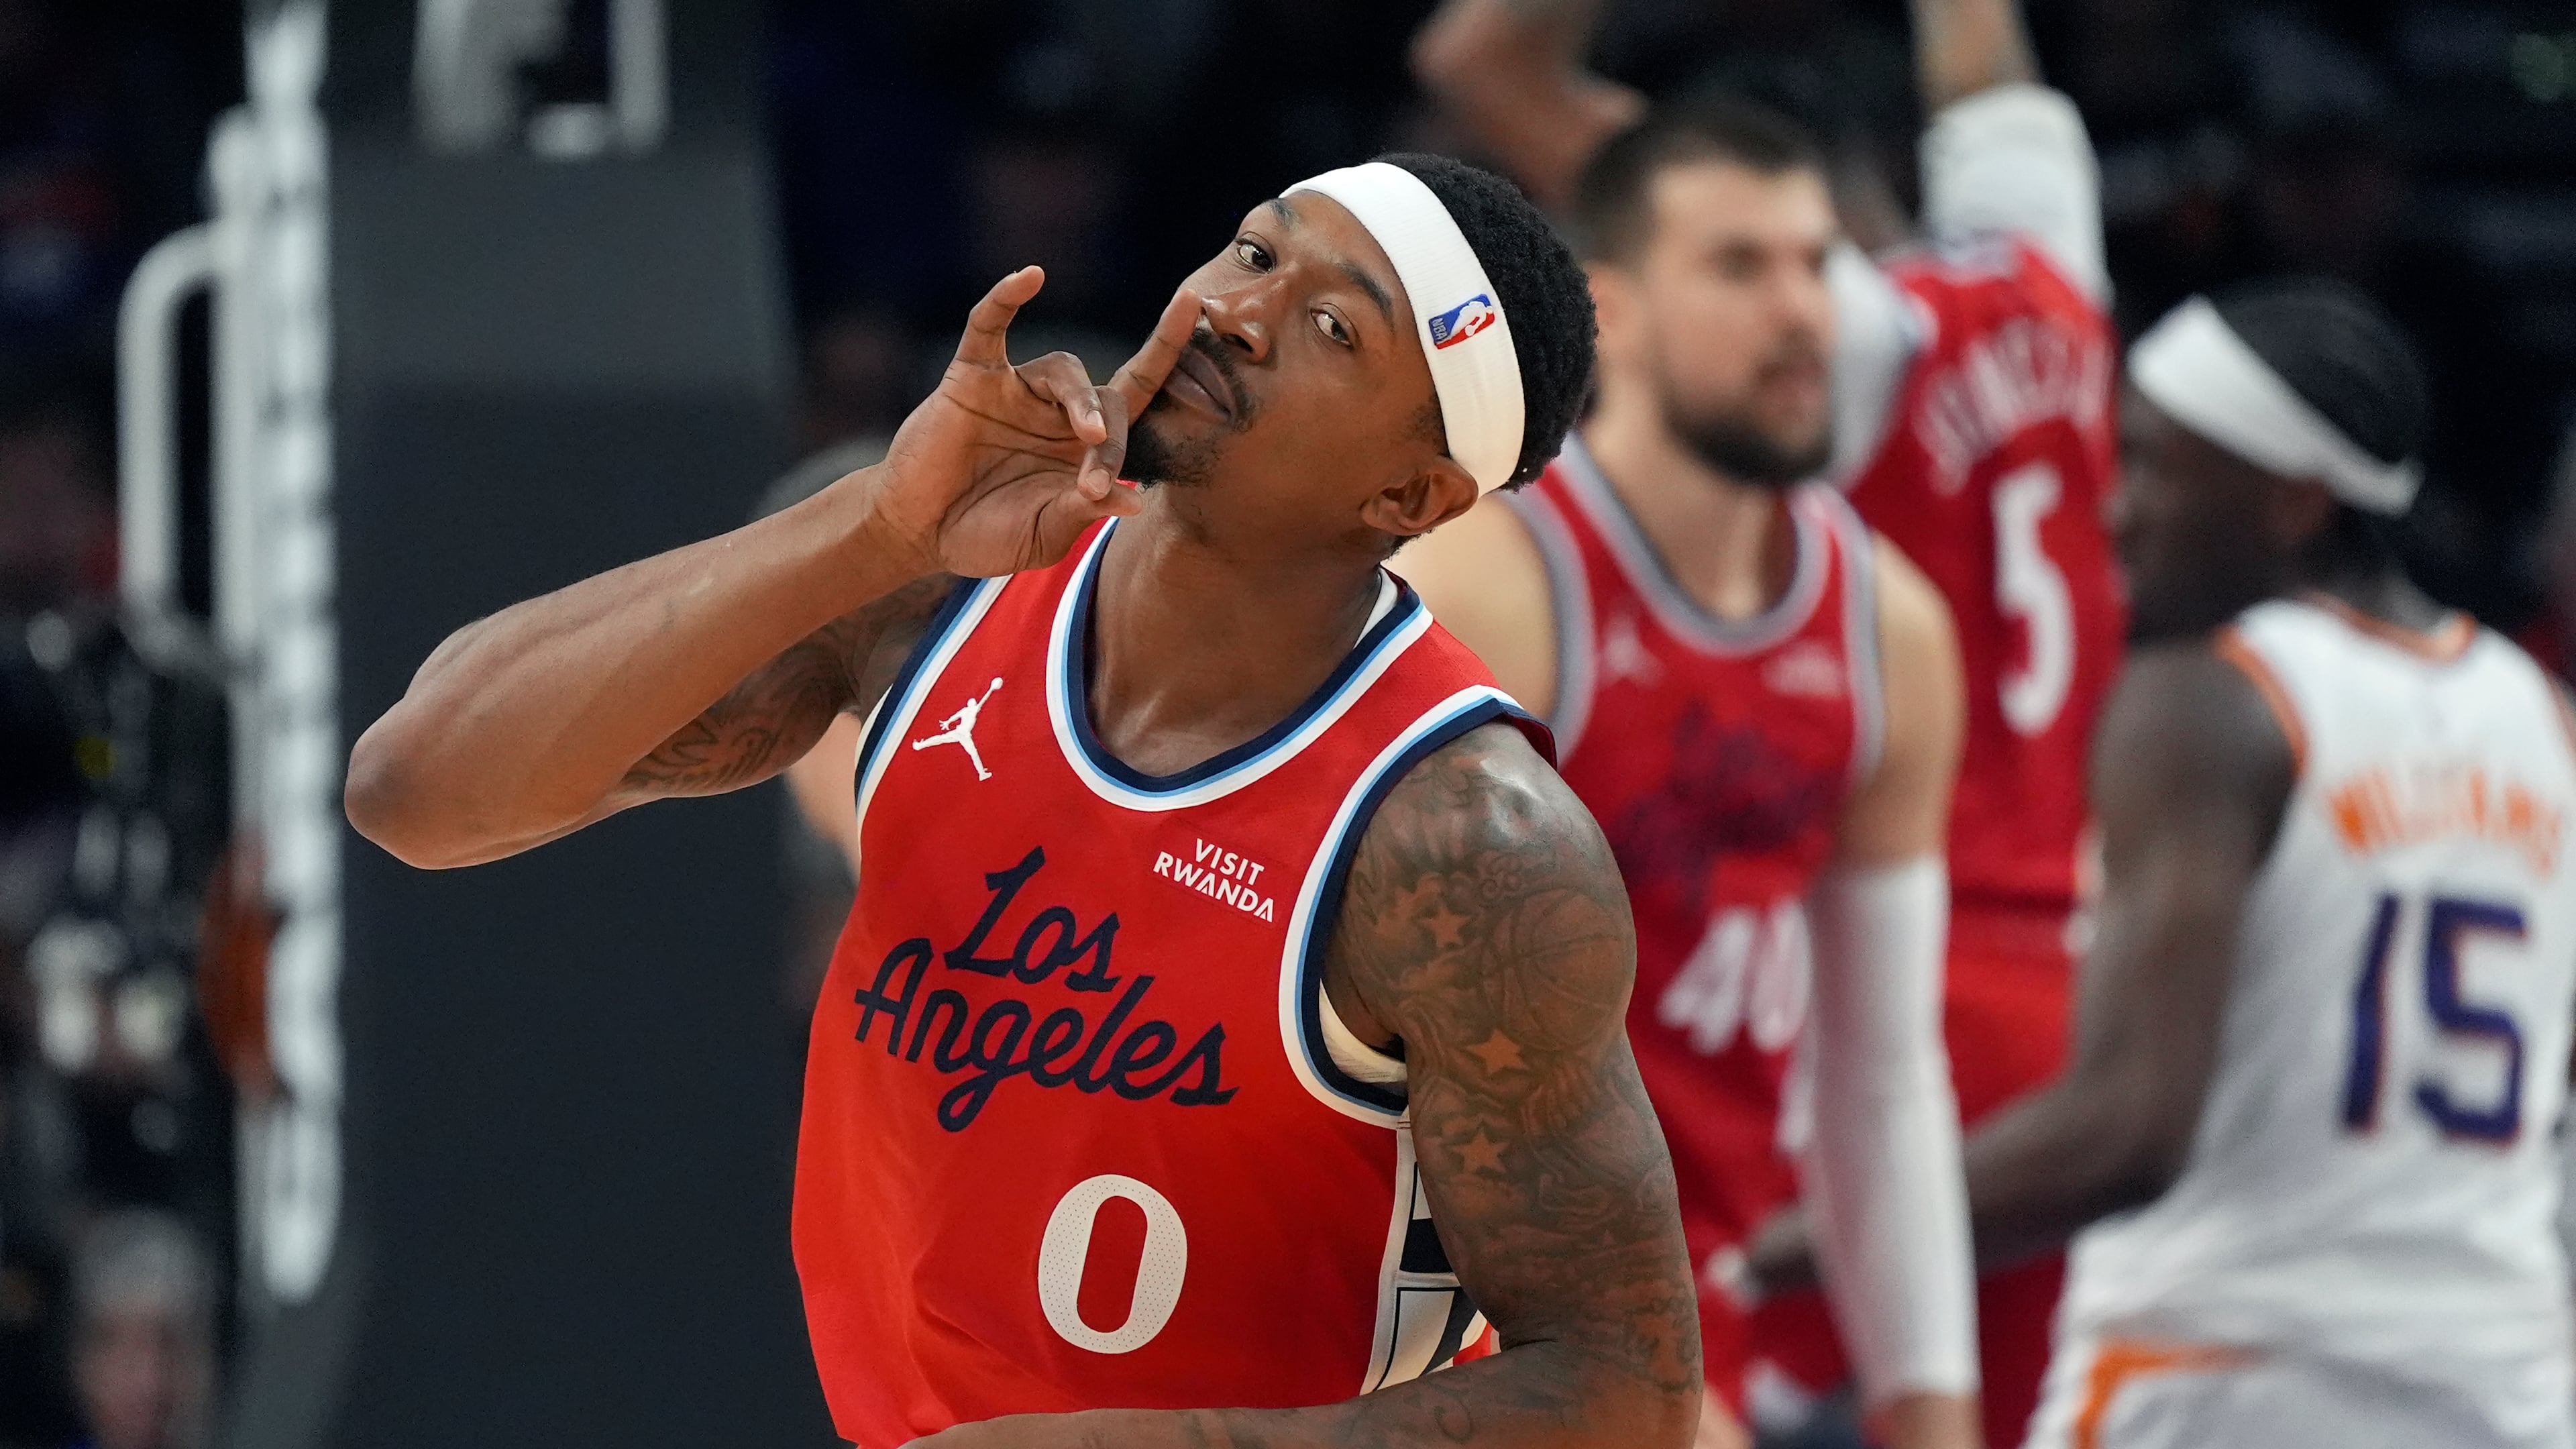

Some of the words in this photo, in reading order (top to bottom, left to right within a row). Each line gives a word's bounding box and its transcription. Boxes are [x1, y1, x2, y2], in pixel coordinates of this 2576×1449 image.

[1432, 317, 1448, 340] NBA
[1992, 463, 2074, 733] 5
[944, 845, 1121, 992] Los
[1152, 851, 1274, 923] RWANDA
[1195, 838, 1265, 886] VISIT
[854, 937, 1240, 1132] Angeles
[1657, 898, 1811, 1053] 40
[2341, 891, 2528, 1148] 15
[1038, 1174, 1188, 1354] 0
